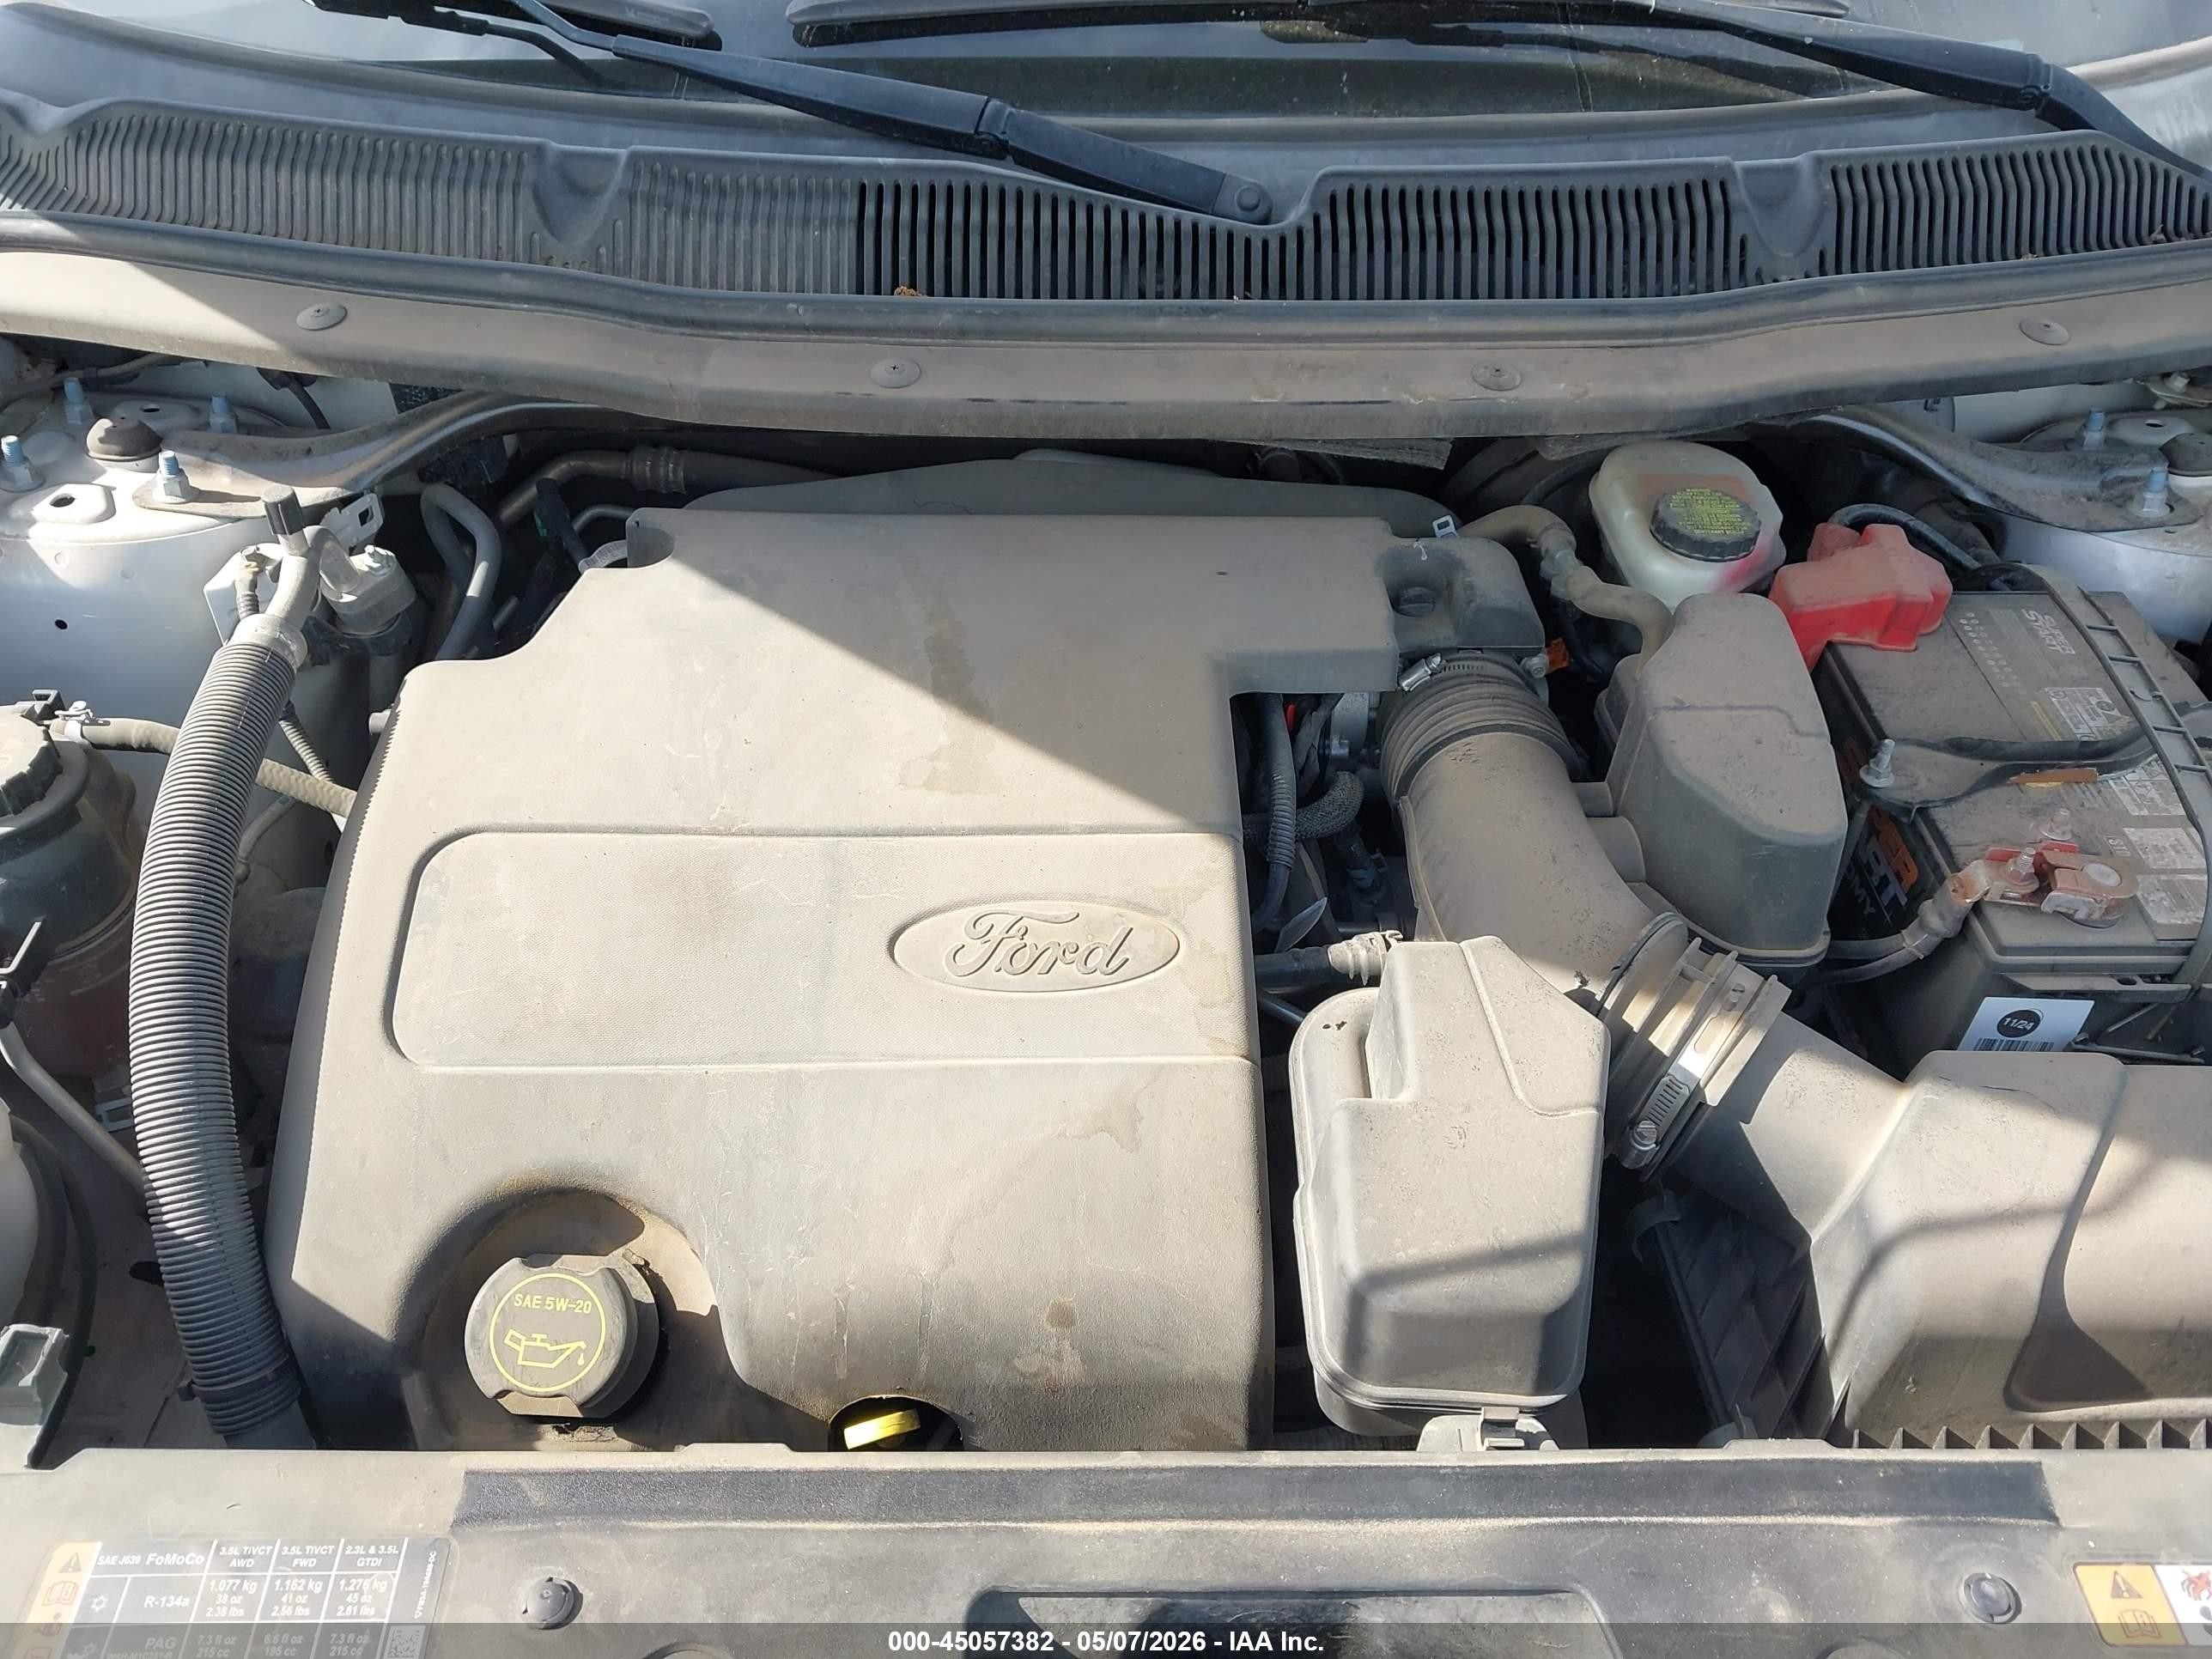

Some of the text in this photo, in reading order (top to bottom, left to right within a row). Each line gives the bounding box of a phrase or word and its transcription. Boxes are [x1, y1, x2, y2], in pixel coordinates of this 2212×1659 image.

[2021, 609, 2061, 652] START
[2043, 615, 2076, 654] SUPER
[945, 911, 1134, 977] Ford
[2003, 1017, 2034, 1030] 11/24
[514, 1293, 592, 1315] SAE 5W-20
[220, 1546, 240, 1555] 3.5L
[282, 1546, 302, 1555] 3.5L
[345, 1546, 399, 1555] 2.3L & 3.5L
[97, 1555, 118, 1565] SAE
[146, 1553, 205, 1565] FoMoCo
[229, 1559, 255, 1567] AWD
[293, 1559, 317, 1567] FWD
[356, 1558, 382, 1567] GTDI
[210, 1579, 258, 1594] 1.077 kg
[275, 1578, 323, 1593] 1.162 kg
[339, 1578, 387, 1592] 1.276 kg
[144, 1595, 190, 1608] R-134a
[216, 1594, 243, 1604] 38 oz
[281, 1593, 308, 1603] 41 oz
[346, 1594, 373, 1603] 45 oz
[206, 1607, 245, 1617] 2.38 lbs
[271, 1606, 310, 1616] 2.56 lbs
[359, 1606, 375, 1616] lbs
[144, 1637, 177, 1650] PAG
[198, 1634, 212, 1645] 7.3
[223, 1636, 237, 1645] oz
[290, 1635, 304, 1644] oz
[330, 1633, 345, 1644] 7.3
[356, 1635, 370, 1644] oz
[216, 1649, 230, 1657] cc
[283, 1648, 297, 1656] cc
[329, 1646, 363, 1656] 215 cc
